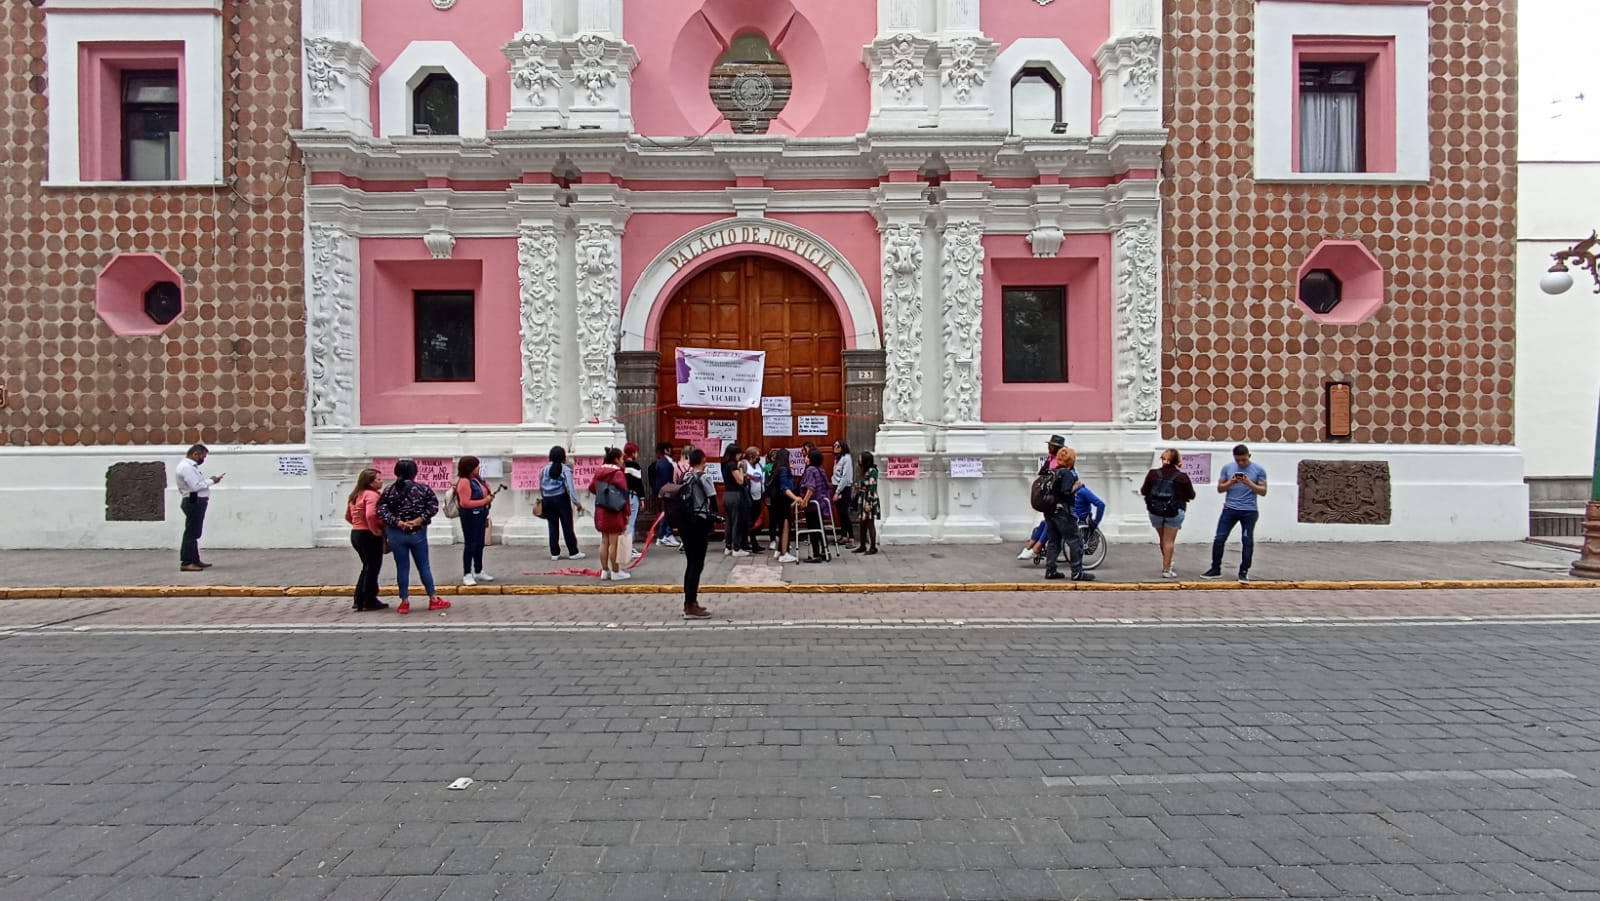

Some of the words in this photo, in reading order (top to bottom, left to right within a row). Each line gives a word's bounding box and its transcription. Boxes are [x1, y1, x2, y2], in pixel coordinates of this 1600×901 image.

[668, 228, 737, 270] PALACIO
[742, 227, 761, 243] DE
[764, 229, 835, 275] JUSTICIA
[706, 385, 747, 394] VIOLENCIA
